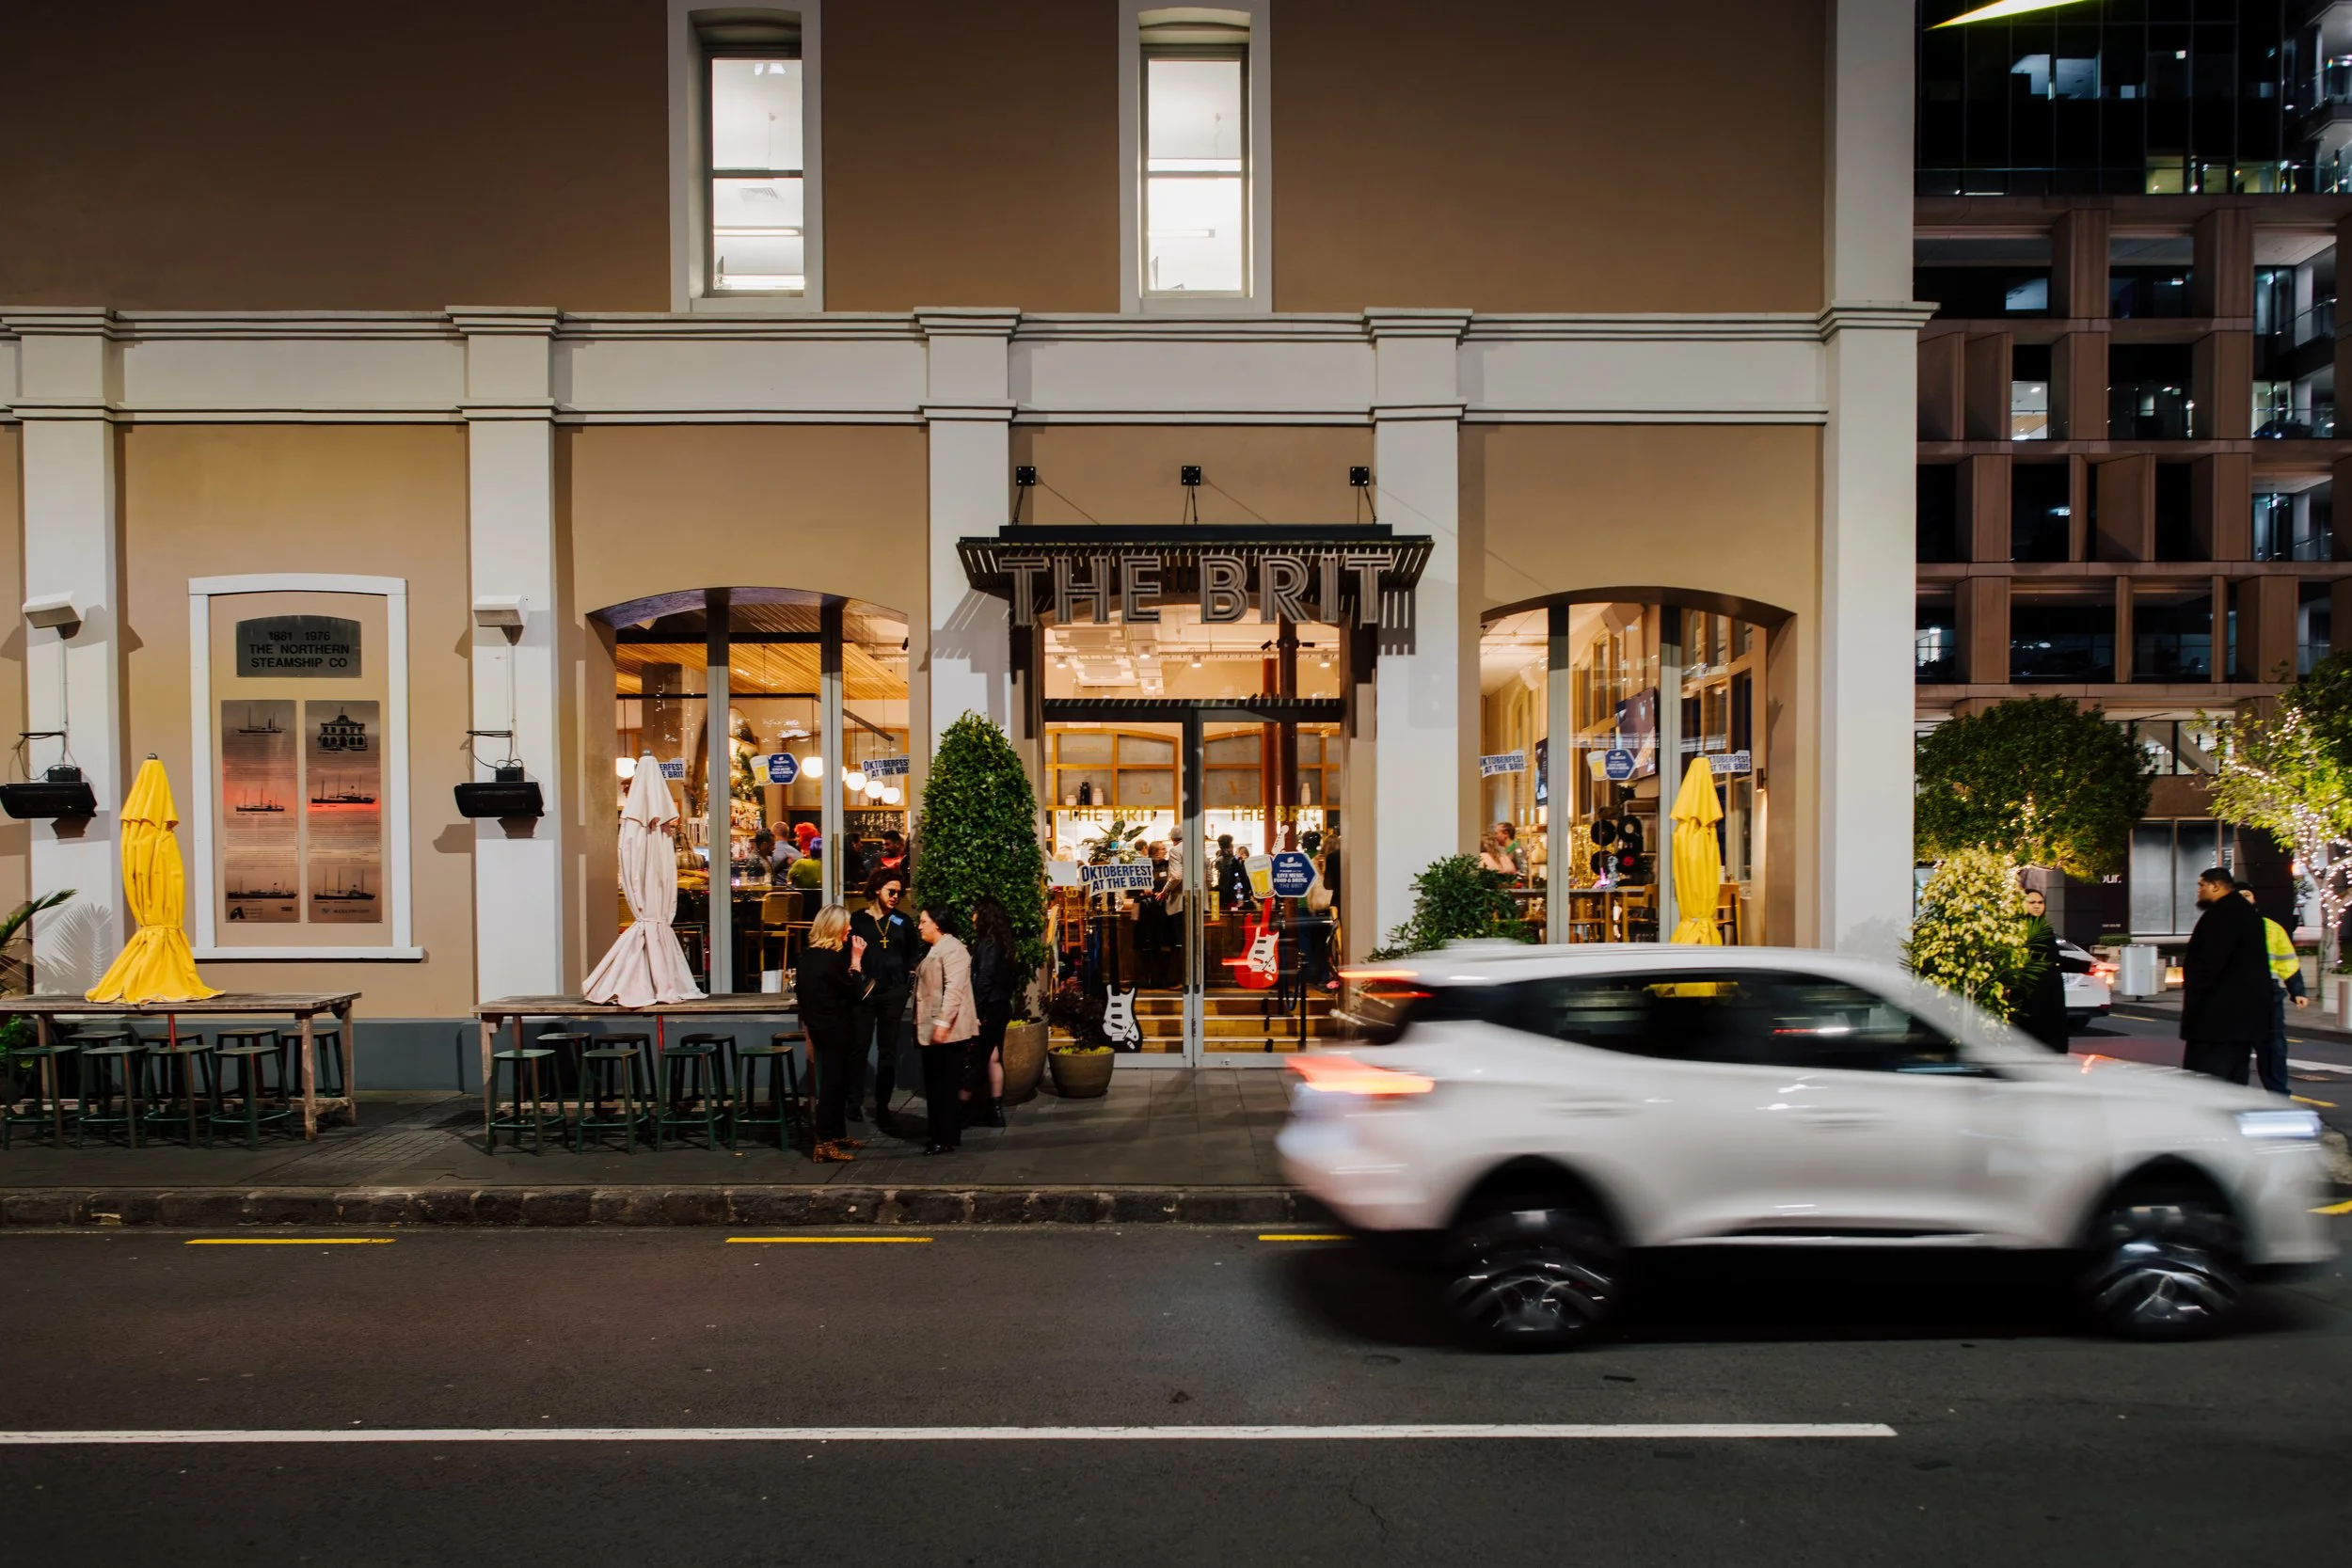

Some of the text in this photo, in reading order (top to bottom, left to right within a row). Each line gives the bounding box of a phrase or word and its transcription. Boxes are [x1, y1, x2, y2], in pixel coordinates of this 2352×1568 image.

[999, 553, 1393, 625] THE BRIT
[268, 631, 330, 641] 1881 1976
[248, 644, 349, 654] THE NORTHERN
[250, 657, 348, 668] STEAMSHIP CO
[659, 763, 683, 771] ERFEST
[863, 758, 910, 771] OKTOBERFES
[667, 770, 684, 779] BRIT
[871, 768, 880, 778] AT
[882, 768, 895, 776] THE
[1066, 805, 1156, 822] THE BRIT
[1228, 805, 1264, 822] THE
[1081, 864, 1152, 882] OKTOBERFEST
[1092, 876, 1153, 893] AT THE BRIT
